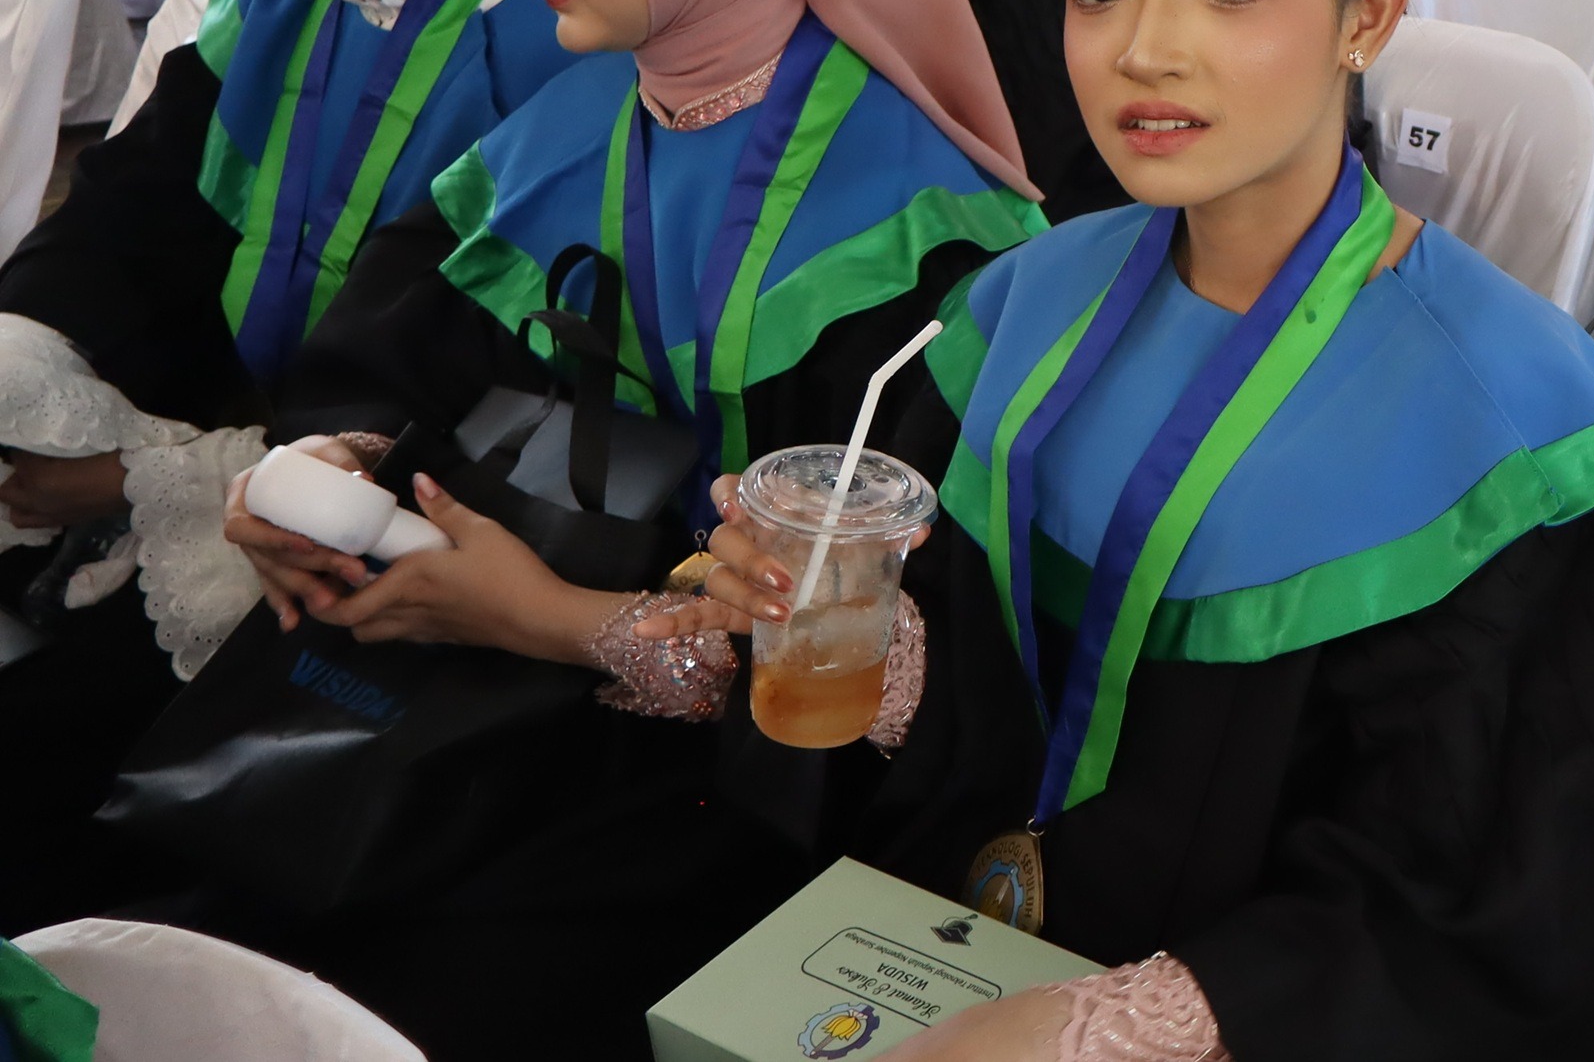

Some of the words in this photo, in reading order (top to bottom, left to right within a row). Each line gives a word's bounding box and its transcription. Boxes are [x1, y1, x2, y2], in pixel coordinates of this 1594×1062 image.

[1409, 125, 1441, 151] 57
[289, 649, 394, 719] WISUDA
[1020, 853, 1036, 918] SEPULUH
[845, 932, 875, 949] Surabaya
[875, 945, 909, 962] Nopember
[836, 965, 878, 991] Sukses
[877, 962, 929, 991] WISUDA
[906, 958, 936, 974] Sepuluh
[935, 968, 968, 987] Teknologi
[887, 988, 941, 1018] Selamat
[966, 983, 995, 999] Institut
